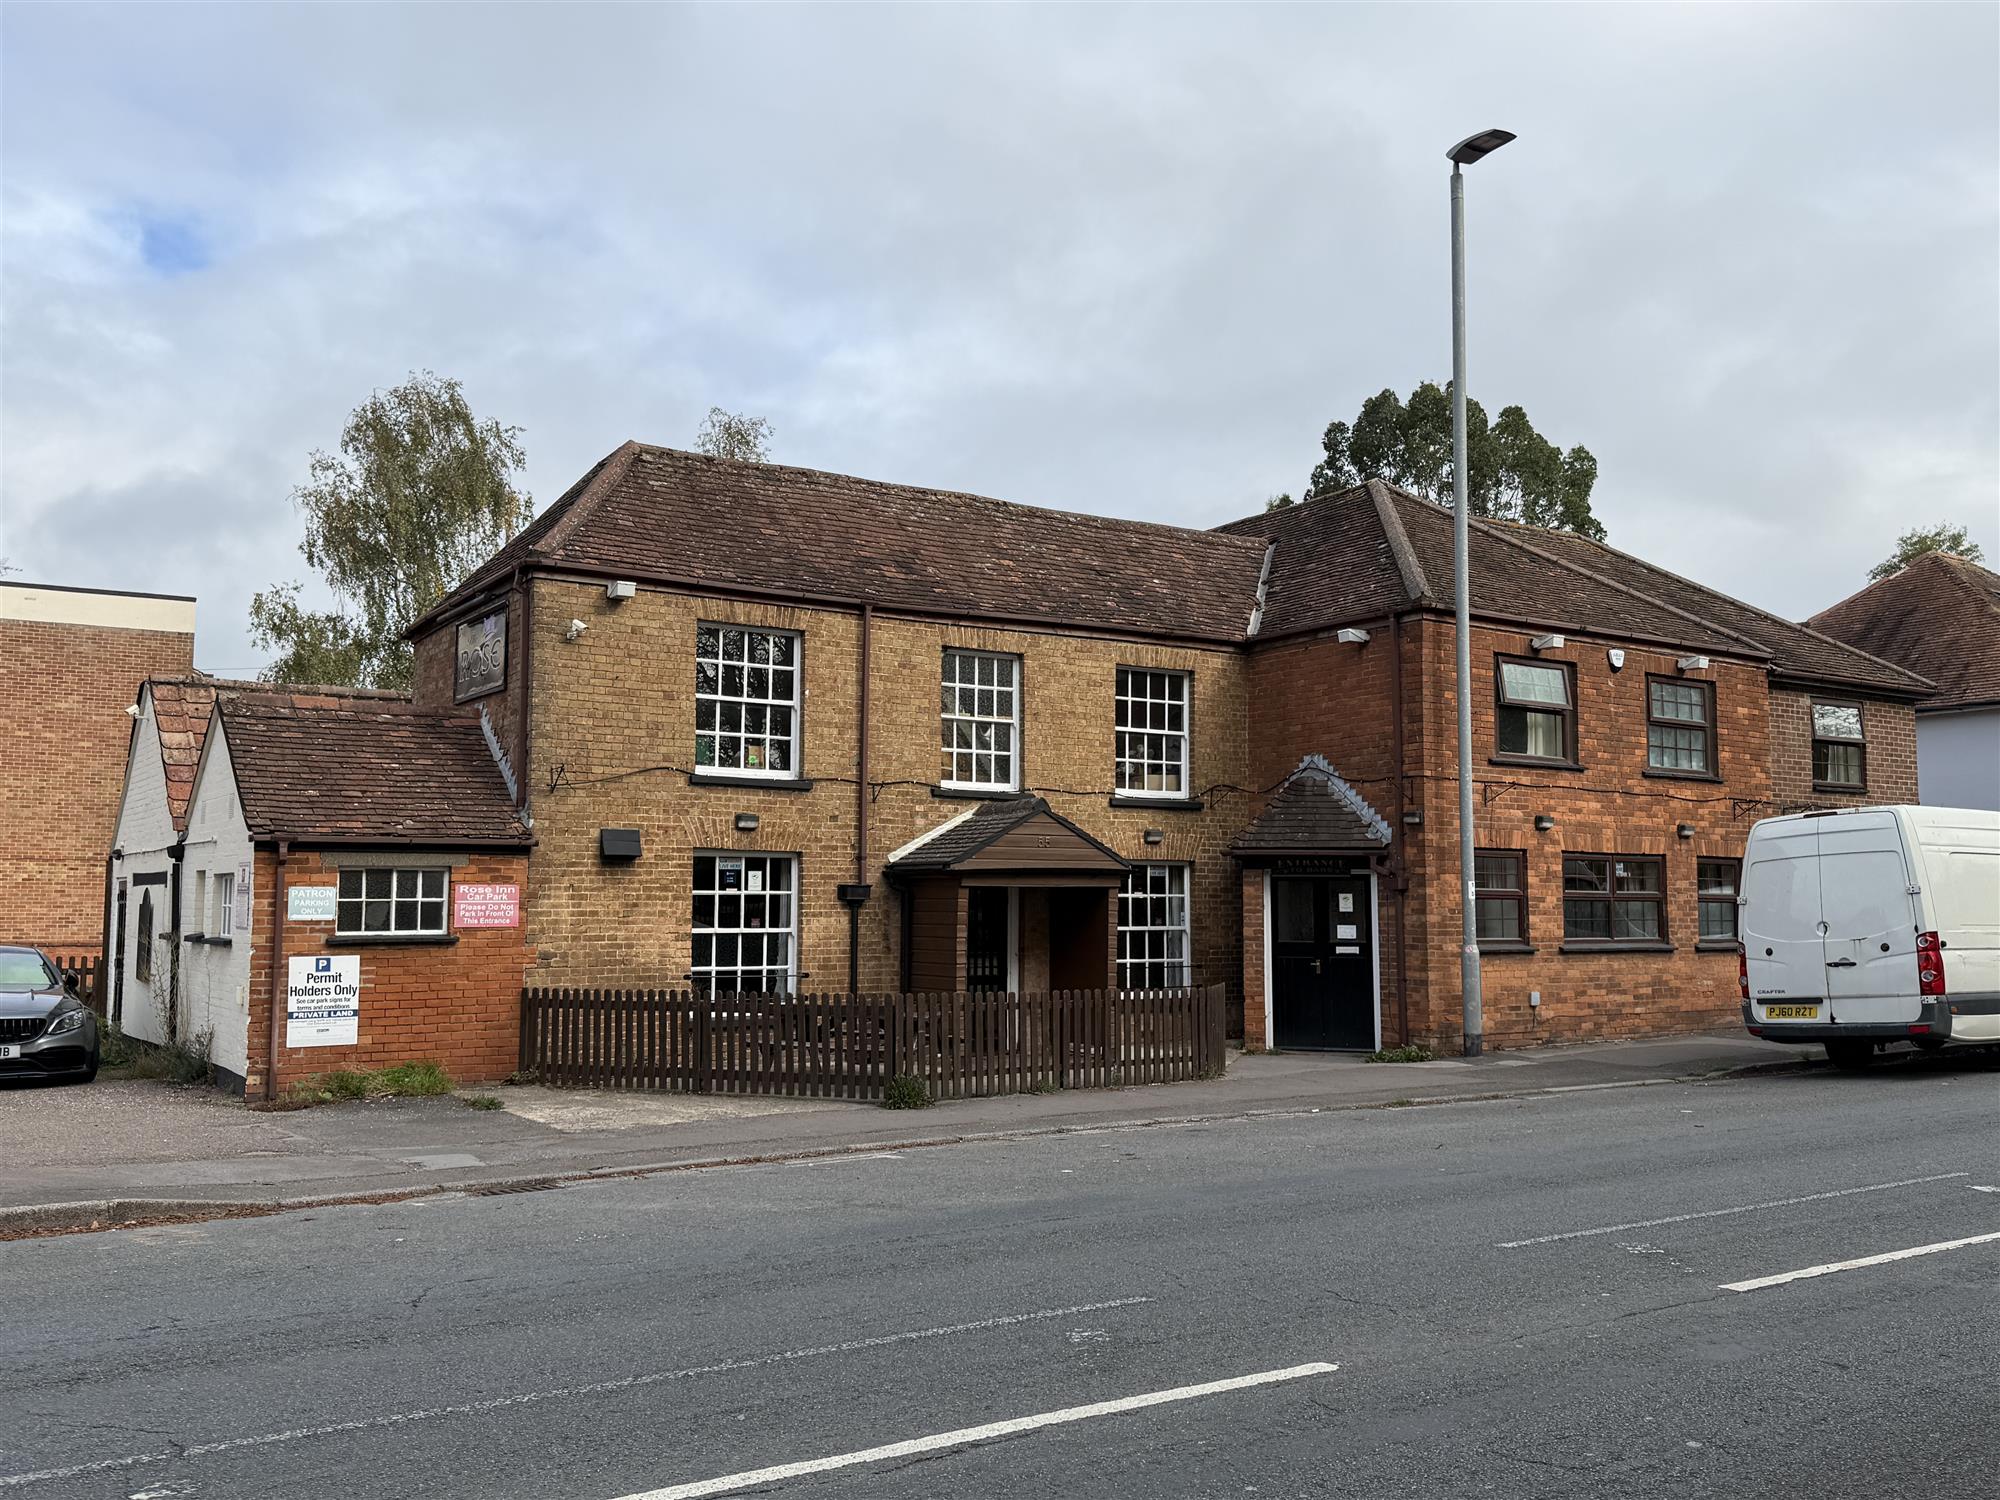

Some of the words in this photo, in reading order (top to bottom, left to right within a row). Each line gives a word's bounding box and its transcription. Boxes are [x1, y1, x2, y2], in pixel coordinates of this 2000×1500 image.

[459, 638, 502, 683] ROSE
[1277, 859, 1343, 868] ENTRANCE
[291, 889, 333, 898] PATRON
[460, 885, 492, 893] Rose
[496, 885, 515, 893] Inn
[294, 899, 330, 907] PARKING
[306, 972, 343, 984] Permit
[290, 985, 331, 997] Holders
[334, 984, 358, 997] Only
[292, 1011, 329, 1019] PRIVATE
[1769, 1007, 1793, 1017] PJ60
